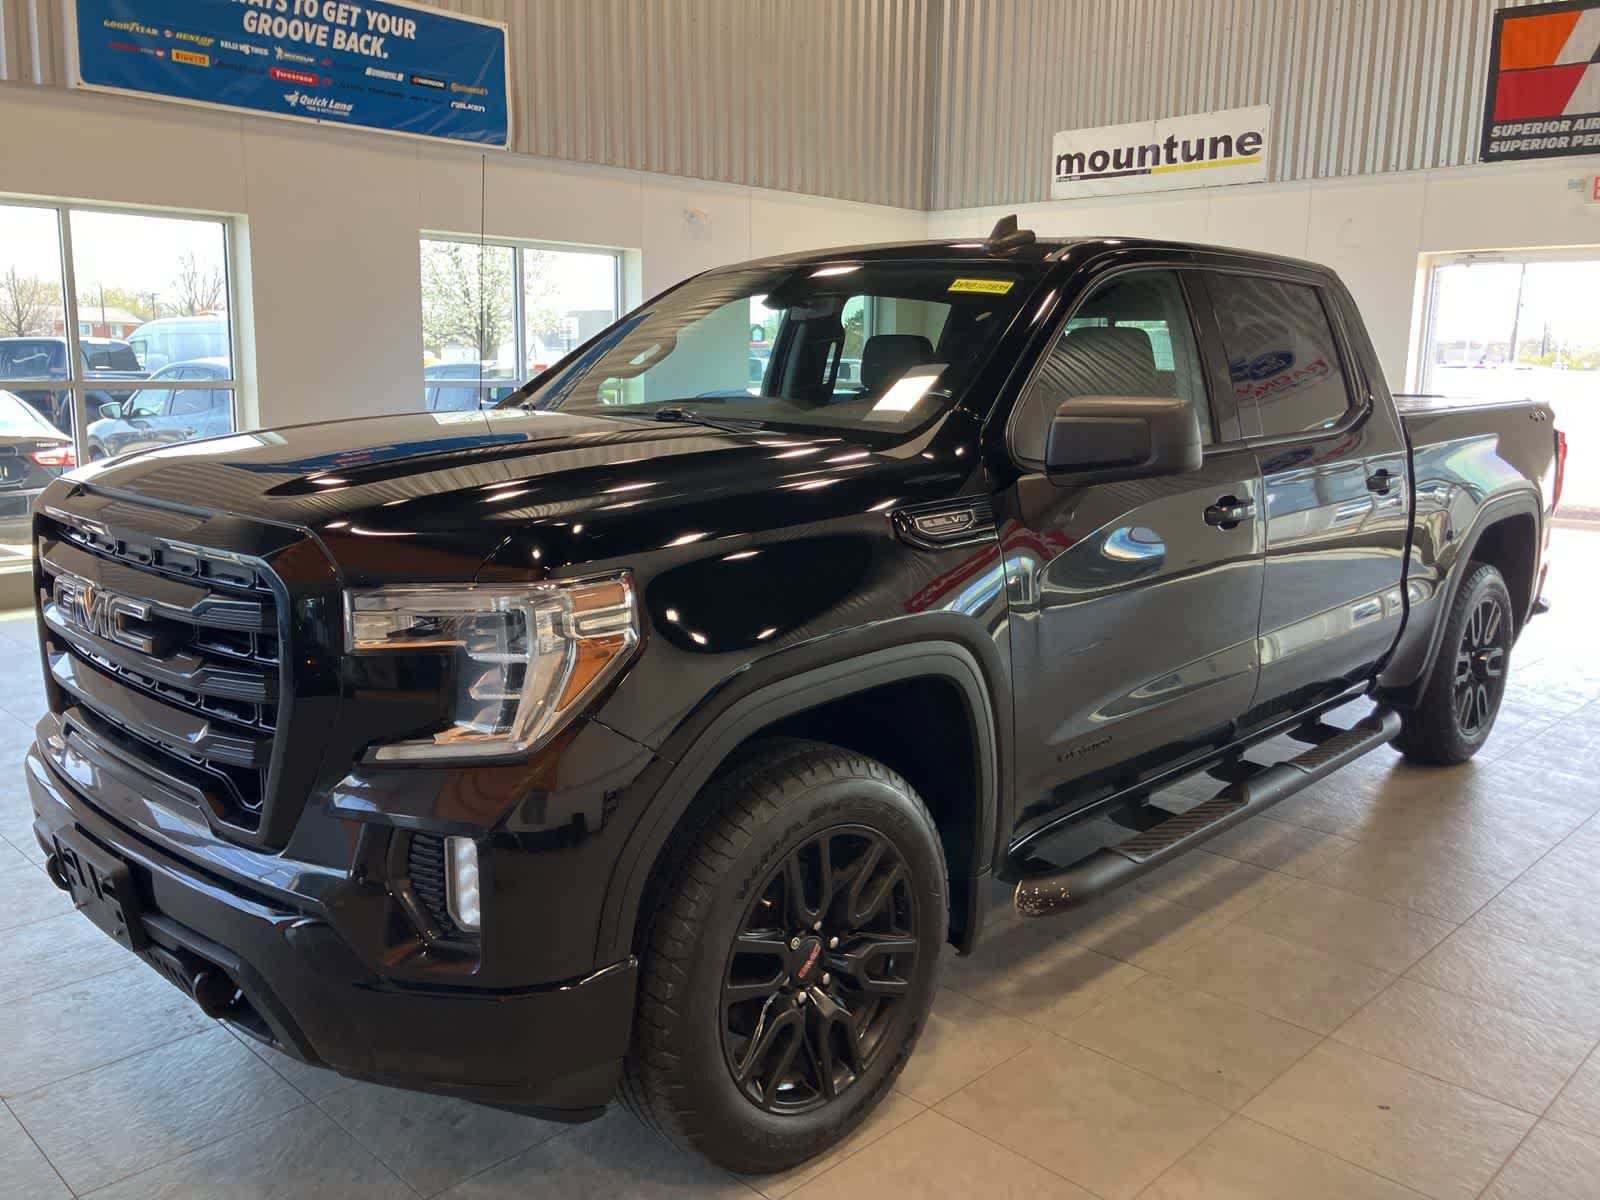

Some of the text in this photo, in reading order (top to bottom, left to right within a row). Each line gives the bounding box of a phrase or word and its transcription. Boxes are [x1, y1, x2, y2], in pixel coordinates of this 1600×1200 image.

[243, 10, 388, 58] GROOVE BACK.
[323, 1, 361, 27] GET
[365, 10, 416, 40] YOUR
[300, 94, 354, 112] Quick Lane
[1489, 136, 1570, 153] SUPERIOR
[1491, 120, 1572, 137] SUPERIOR
[1056, 131, 1263, 175] mountune
[53, 577, 152, 653] GMC
